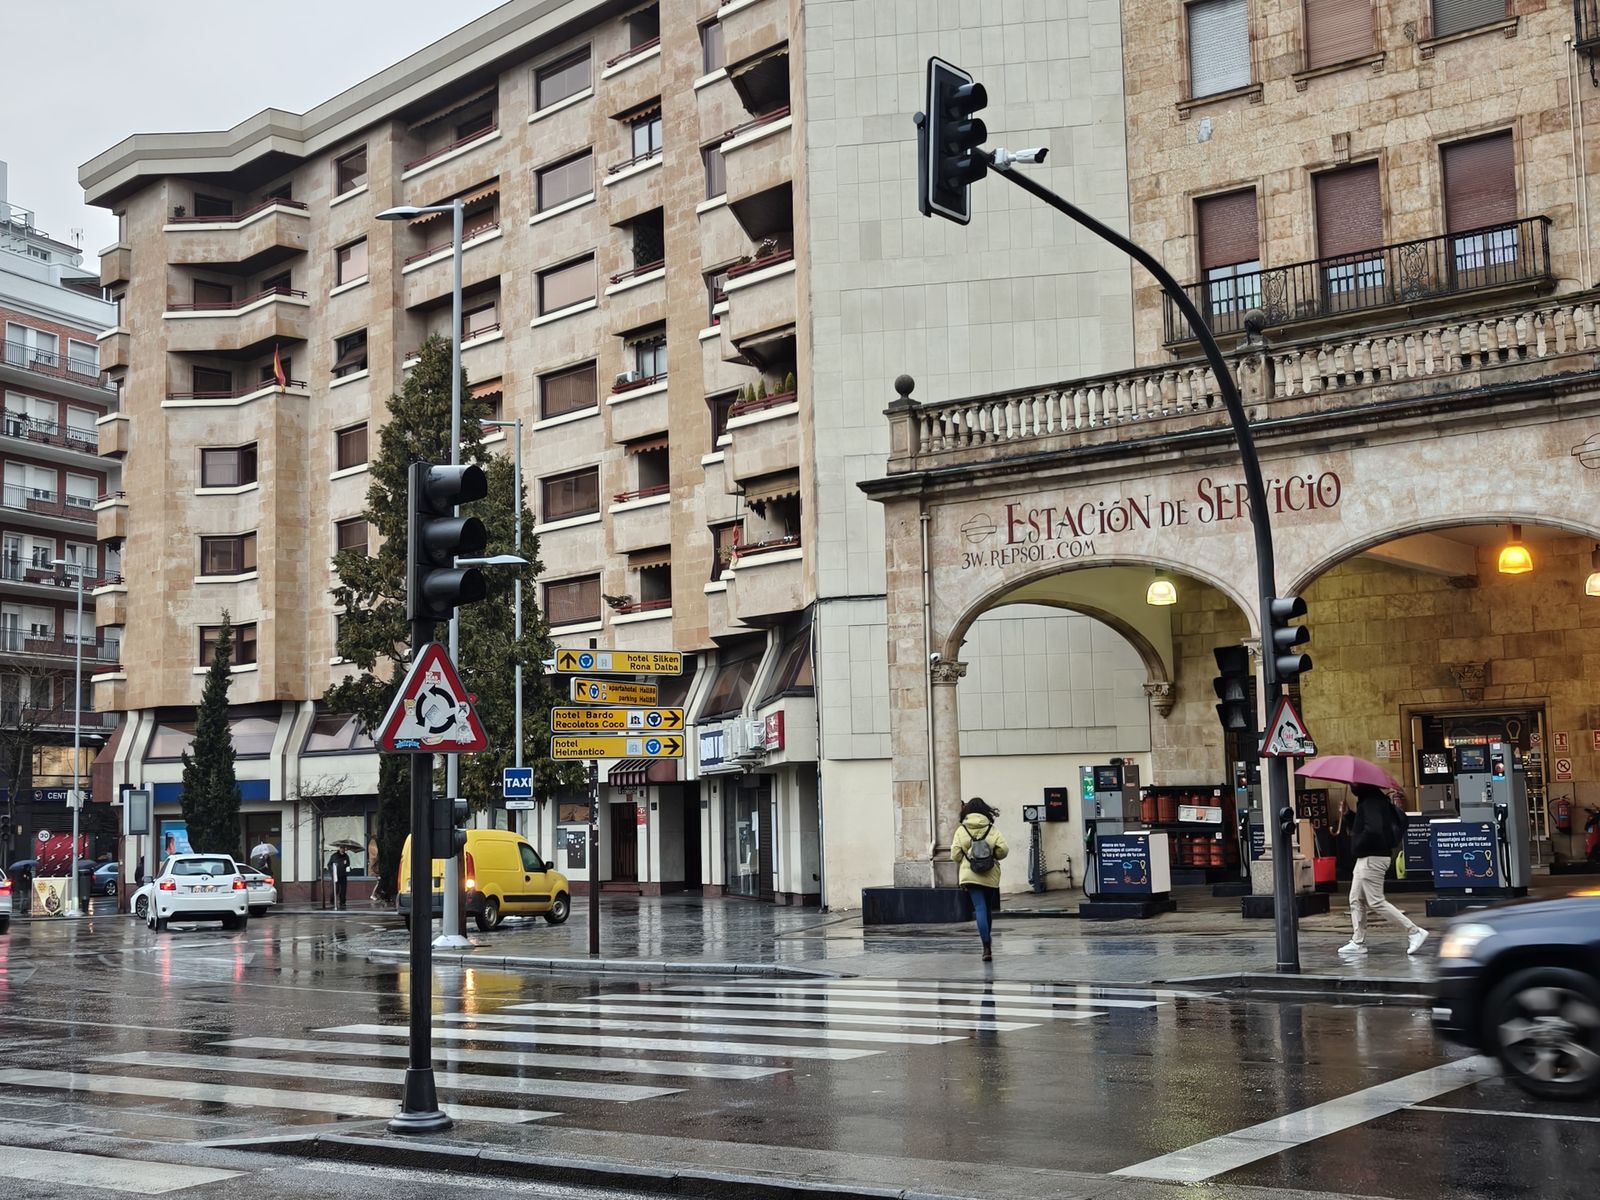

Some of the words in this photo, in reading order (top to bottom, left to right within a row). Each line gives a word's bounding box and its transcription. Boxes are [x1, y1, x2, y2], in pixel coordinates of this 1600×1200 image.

[1160, 498, 1190, 527] DE
[627, 654, 649, 663] hotel
[652, 654, 679, 663] Silken
[630, 662, 651, 671] Rona
[654, 663, 679, 671] Dalba
[555, 711, 580, 719] hotel
[586, 711, 614, 719] Bardo
[555, 720, 599, 729] Recoletos
[602, 720, 625, 729] Coco
[555, 740, 578, 748] hotel
[555, 748, 605, 756] Helmántico
[505, 777, 532, 788] TAXI
[47, 792, 68, 800] CENT
